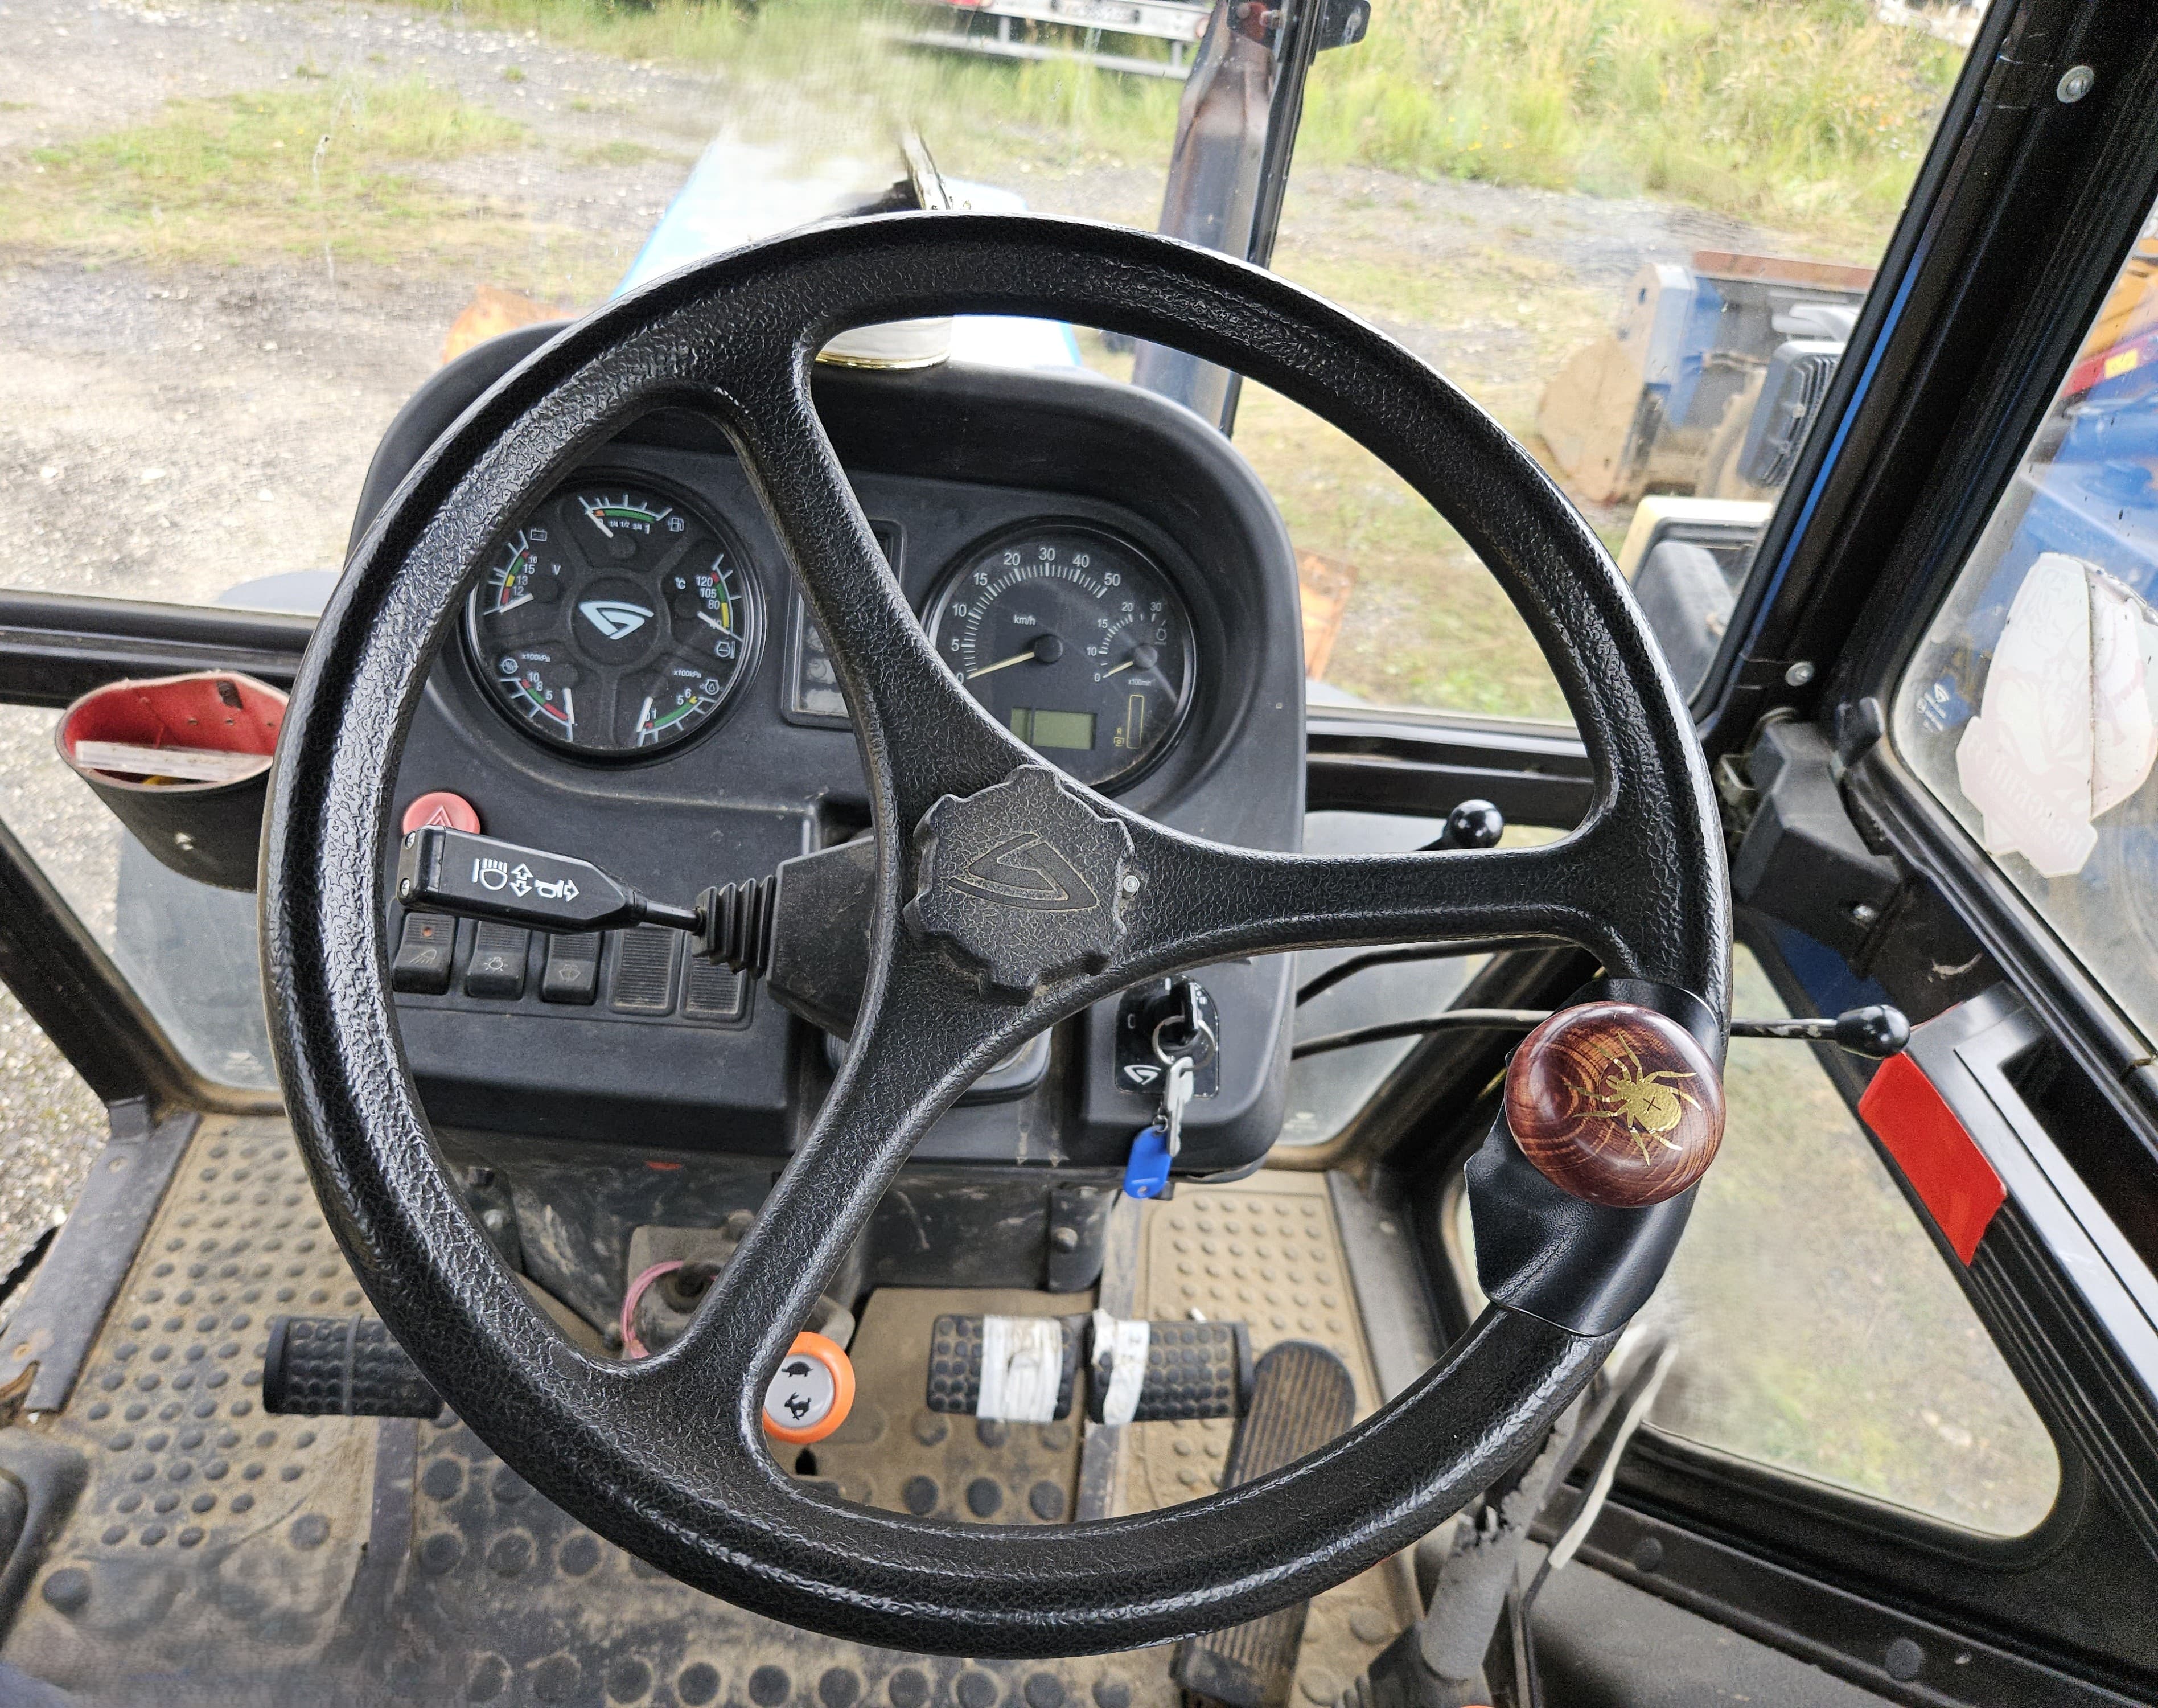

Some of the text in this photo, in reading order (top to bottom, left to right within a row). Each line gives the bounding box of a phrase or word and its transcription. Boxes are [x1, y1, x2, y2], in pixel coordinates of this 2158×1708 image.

[644, 523, 650, 534] 1
[1003, 552, 1020, 566] 20
[1038, 547, 1055, 561] 30
[1072, 554, 1090, 568] 40
[523, 563, 535, 574] 15
[552, 564, 561, 576] V
[517, 574, 528, 586] 13
[696, 575, 713, 588] 120
[973, 572, 988, 586] 15
[1104, 572, 1121, 586] 50
[513, 586, 524, 596] 12
[700, 587, 717, 599] 105
[708, 599, 720, 610] 80
[952, 603, 967, 617] 10
[1121, 601, 1134, 612] 20
[1150, 601, 1162, 612] 30
[1013, 614, 1036, 626] km/h
[1096, 619, 1108, 628] 15
[951, 638, 960, 651] 5
[1086, 646, 1097, 656] 10
[528, 671, 540, 683] 10
[1094, 672, 1101, 683] 0
[536, 681, 543, 692] 8
[545, 689, 553, 701] 5
[685, 688, 692, 699] 6
[677, 695, 684, 705] 5
[651, 707, 657, 719] 1
